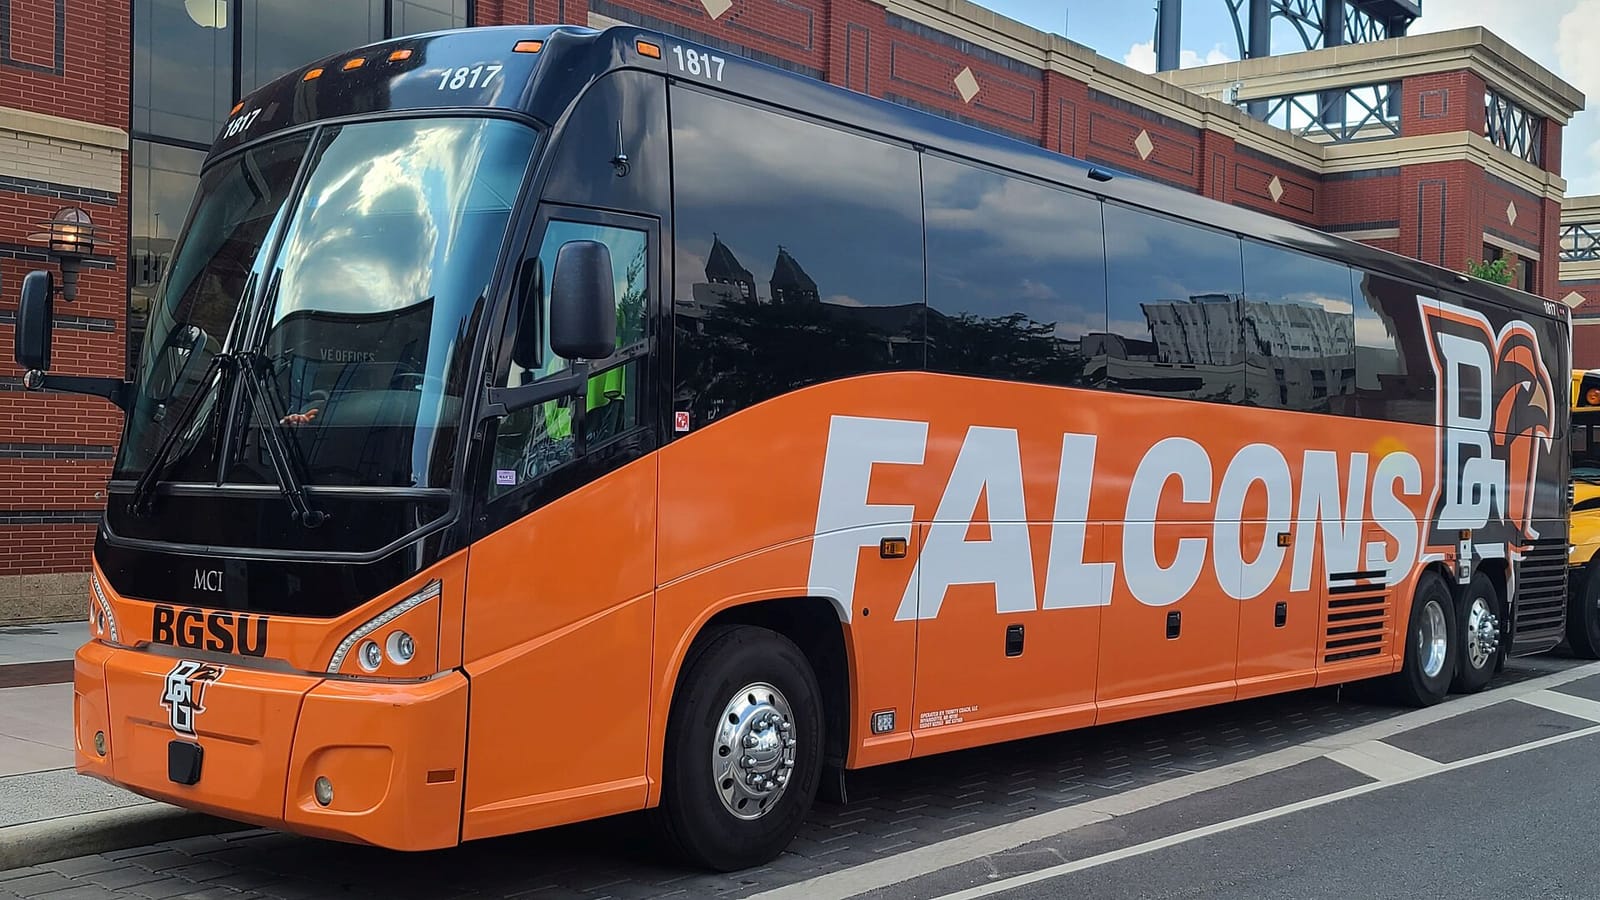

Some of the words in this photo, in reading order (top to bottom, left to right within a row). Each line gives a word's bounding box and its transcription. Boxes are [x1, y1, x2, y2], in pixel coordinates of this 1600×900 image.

[438, 64, 504, 91] 1817
[673, 45, 725, 82] 1817
[223, 108, 262, 140] 1817
[1543, 300, 1556, 316] 1817
[335, 349, 376, 362] OFFICES
[807, 414, 1423, 625] FALCONS
[193, 568, 224, 592] MCI
[152, 605, 269, 658] BGSU
